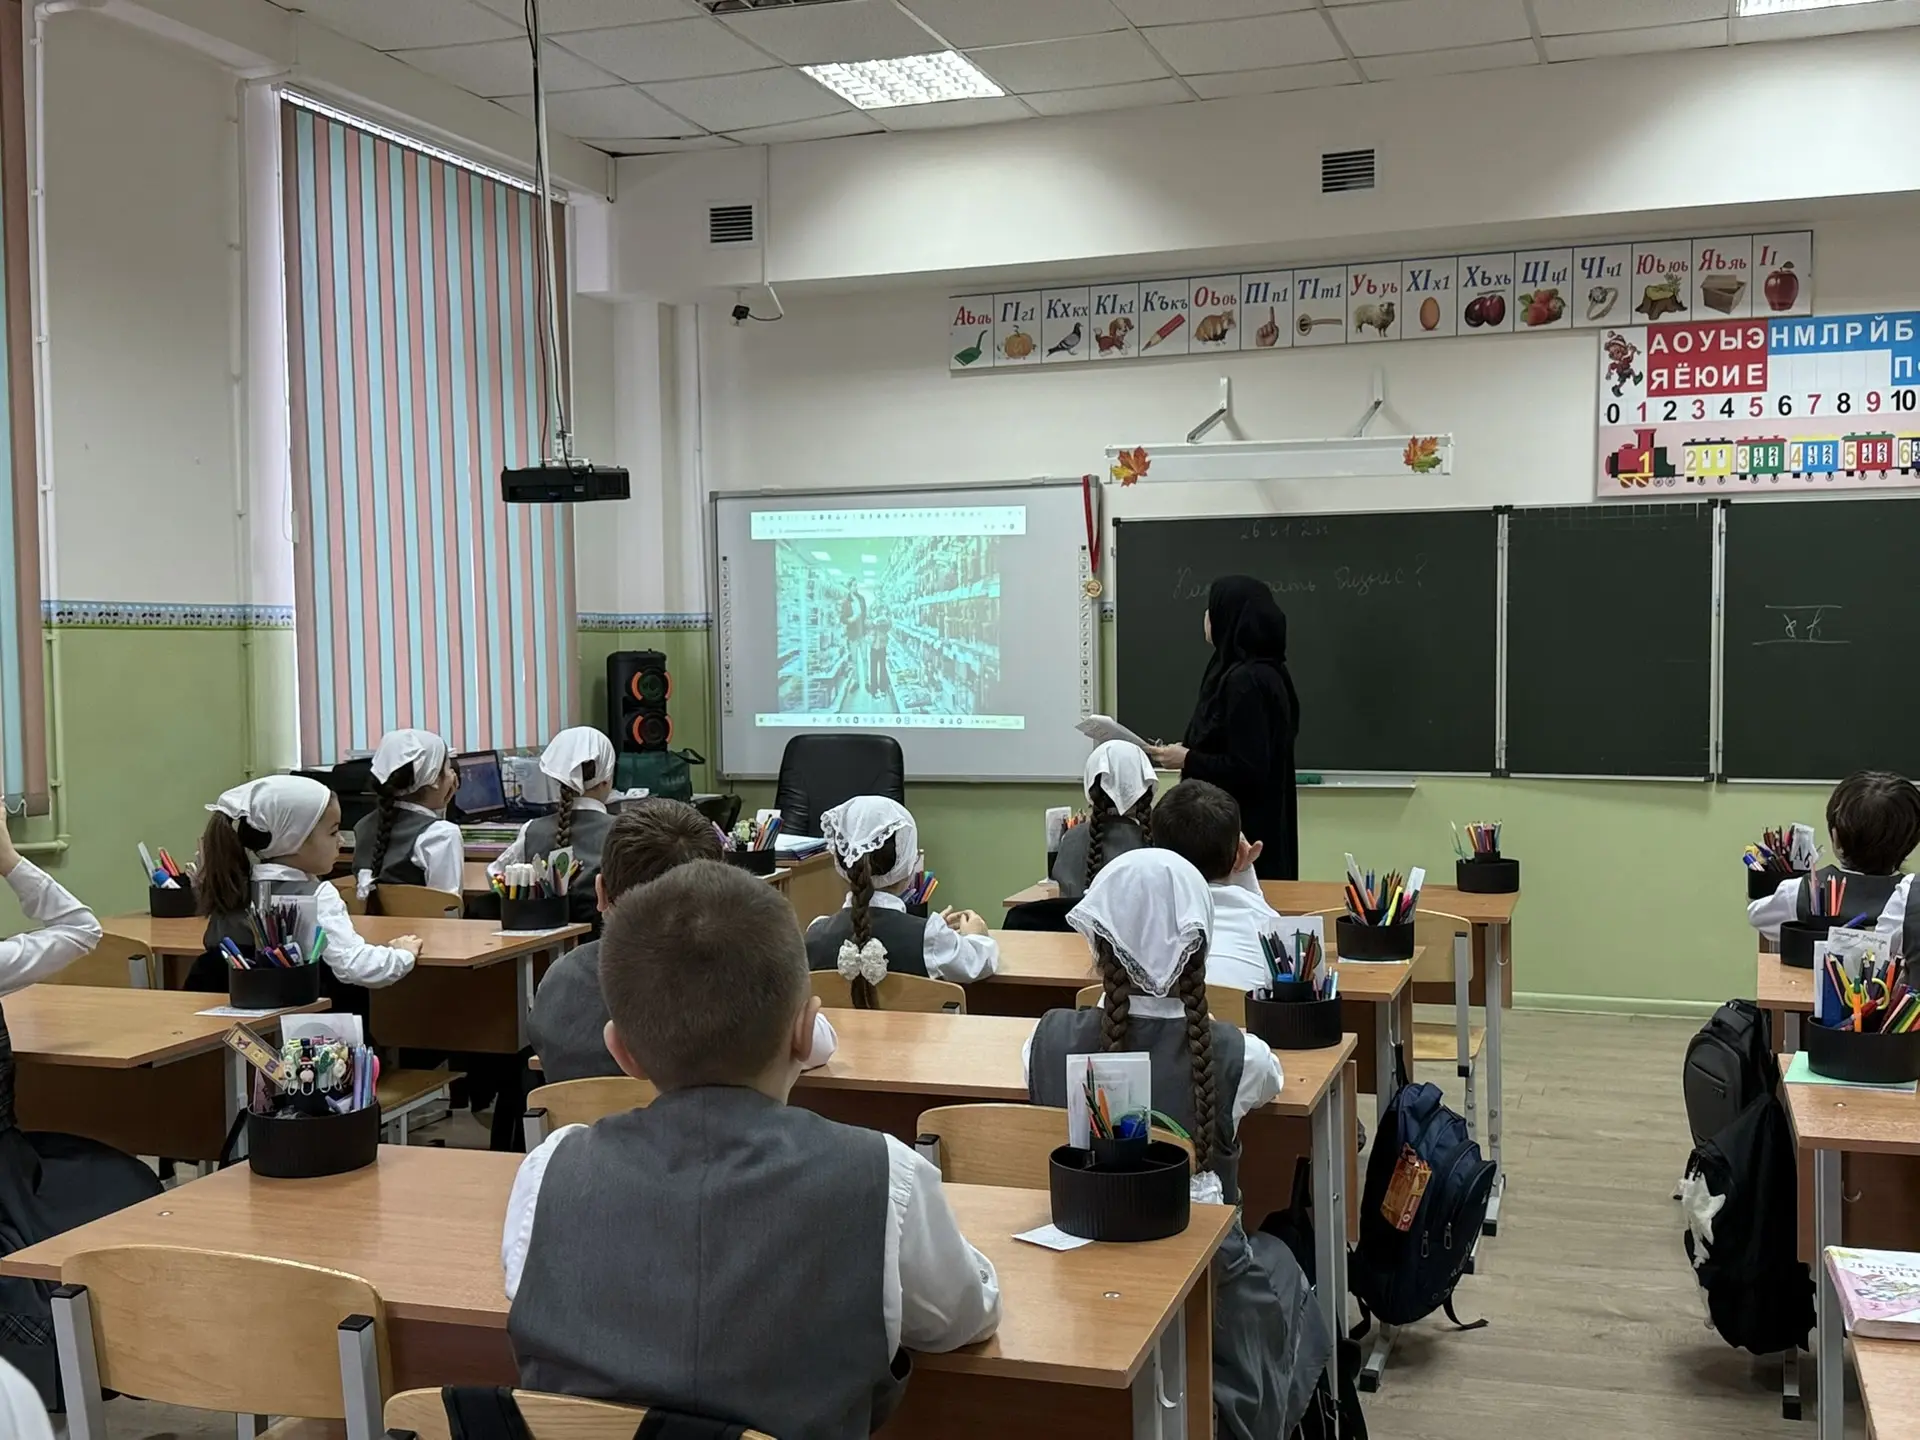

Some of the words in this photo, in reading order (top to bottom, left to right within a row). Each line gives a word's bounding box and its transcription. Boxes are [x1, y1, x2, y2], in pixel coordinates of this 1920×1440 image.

[1606, 403, 1620, 423] 0
[1636, 402, 1647, 422] 1
[1663, 400, 1677, 421] 2
[1691, 399, 1705, 420] 3
[1720, 398, 1735, 418] 4
[1749, 397, 1763, 417] 5
[1778, 395, 1792, 415] 6
[1808, 394, 1822, 415] 7
[1836, 393, 1851, 413] 8
[1866, 391, 1881, 412] 9
[1891, 390, 1916, 411] 10
[1638, 451, 1650, 474] 1
[1686, 450, 1696, 471] 2
[1739, 449, 1748, 469] 3
[1791, 447, 1801, 467] 4
[1846, 444, 1856, 466] 5
[1900, 442, 1910, 463] 6
